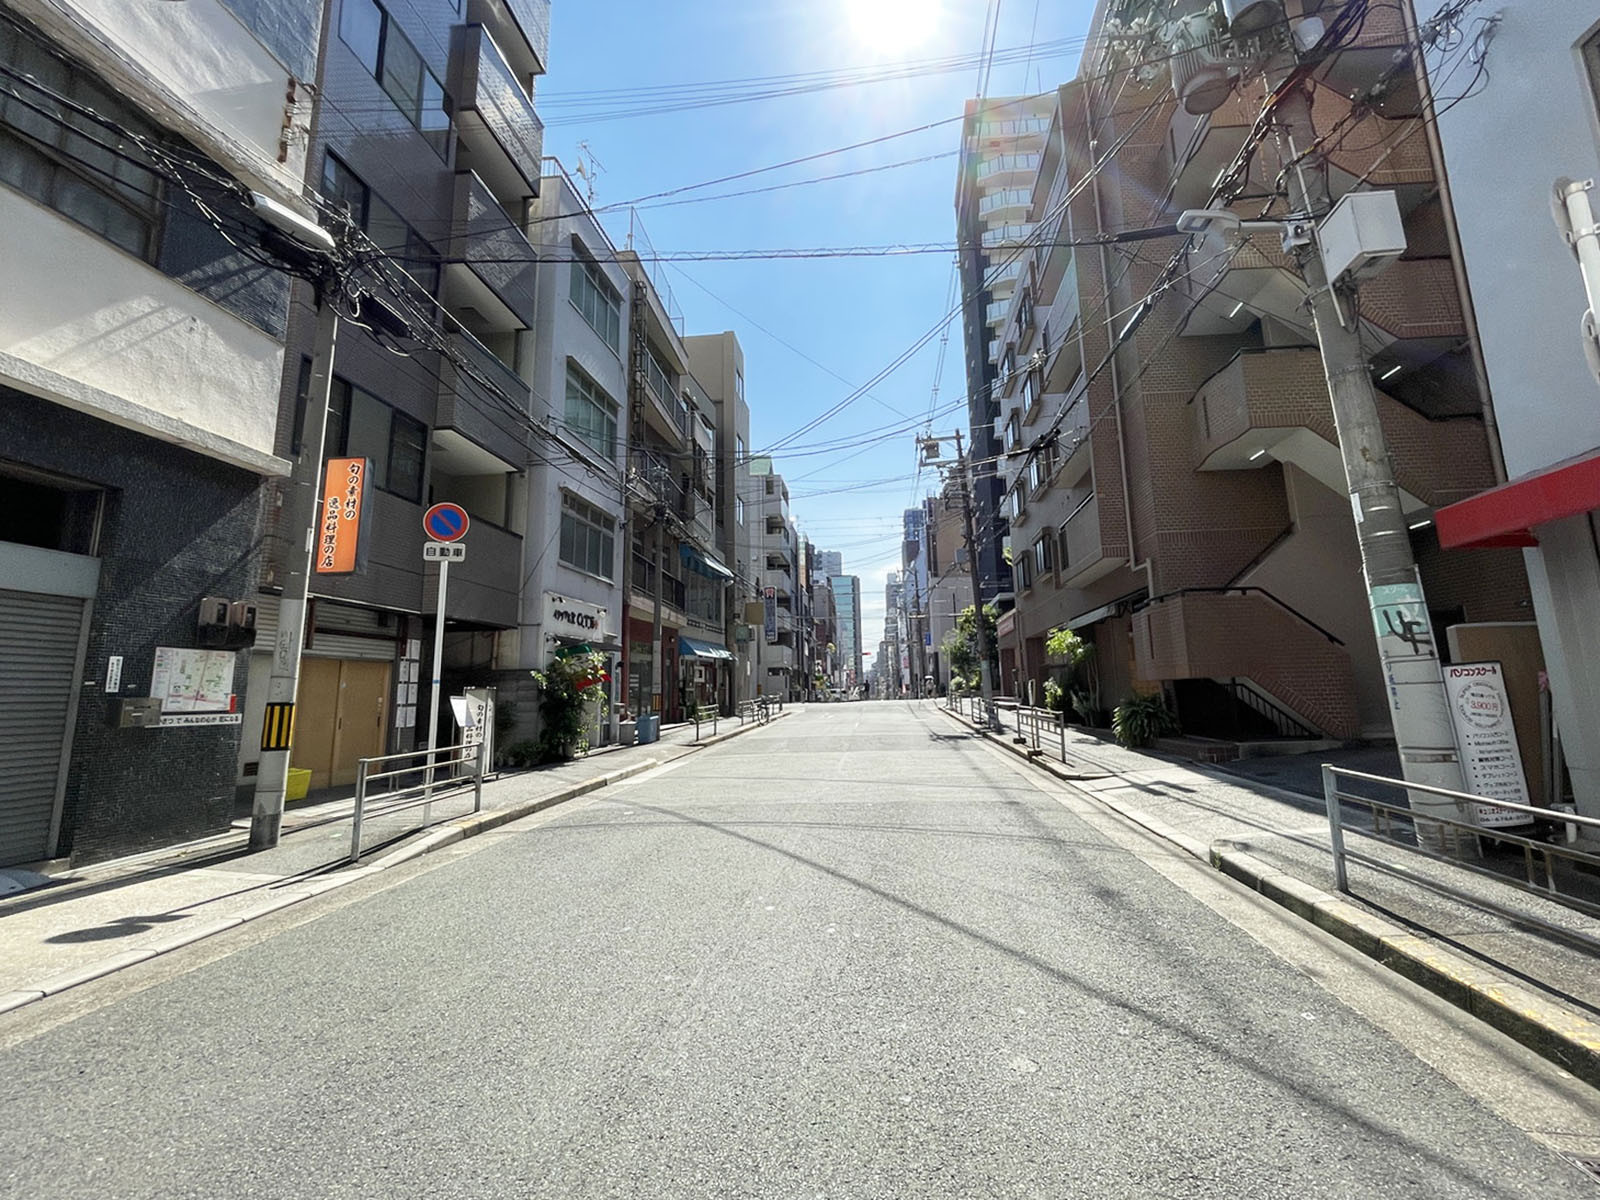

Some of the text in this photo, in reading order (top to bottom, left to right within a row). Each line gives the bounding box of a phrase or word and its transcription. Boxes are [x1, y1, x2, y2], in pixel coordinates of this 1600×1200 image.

[425, 546, 464, 558] 自動車
[1450, 667, 1497, 678] パソコンスクール
